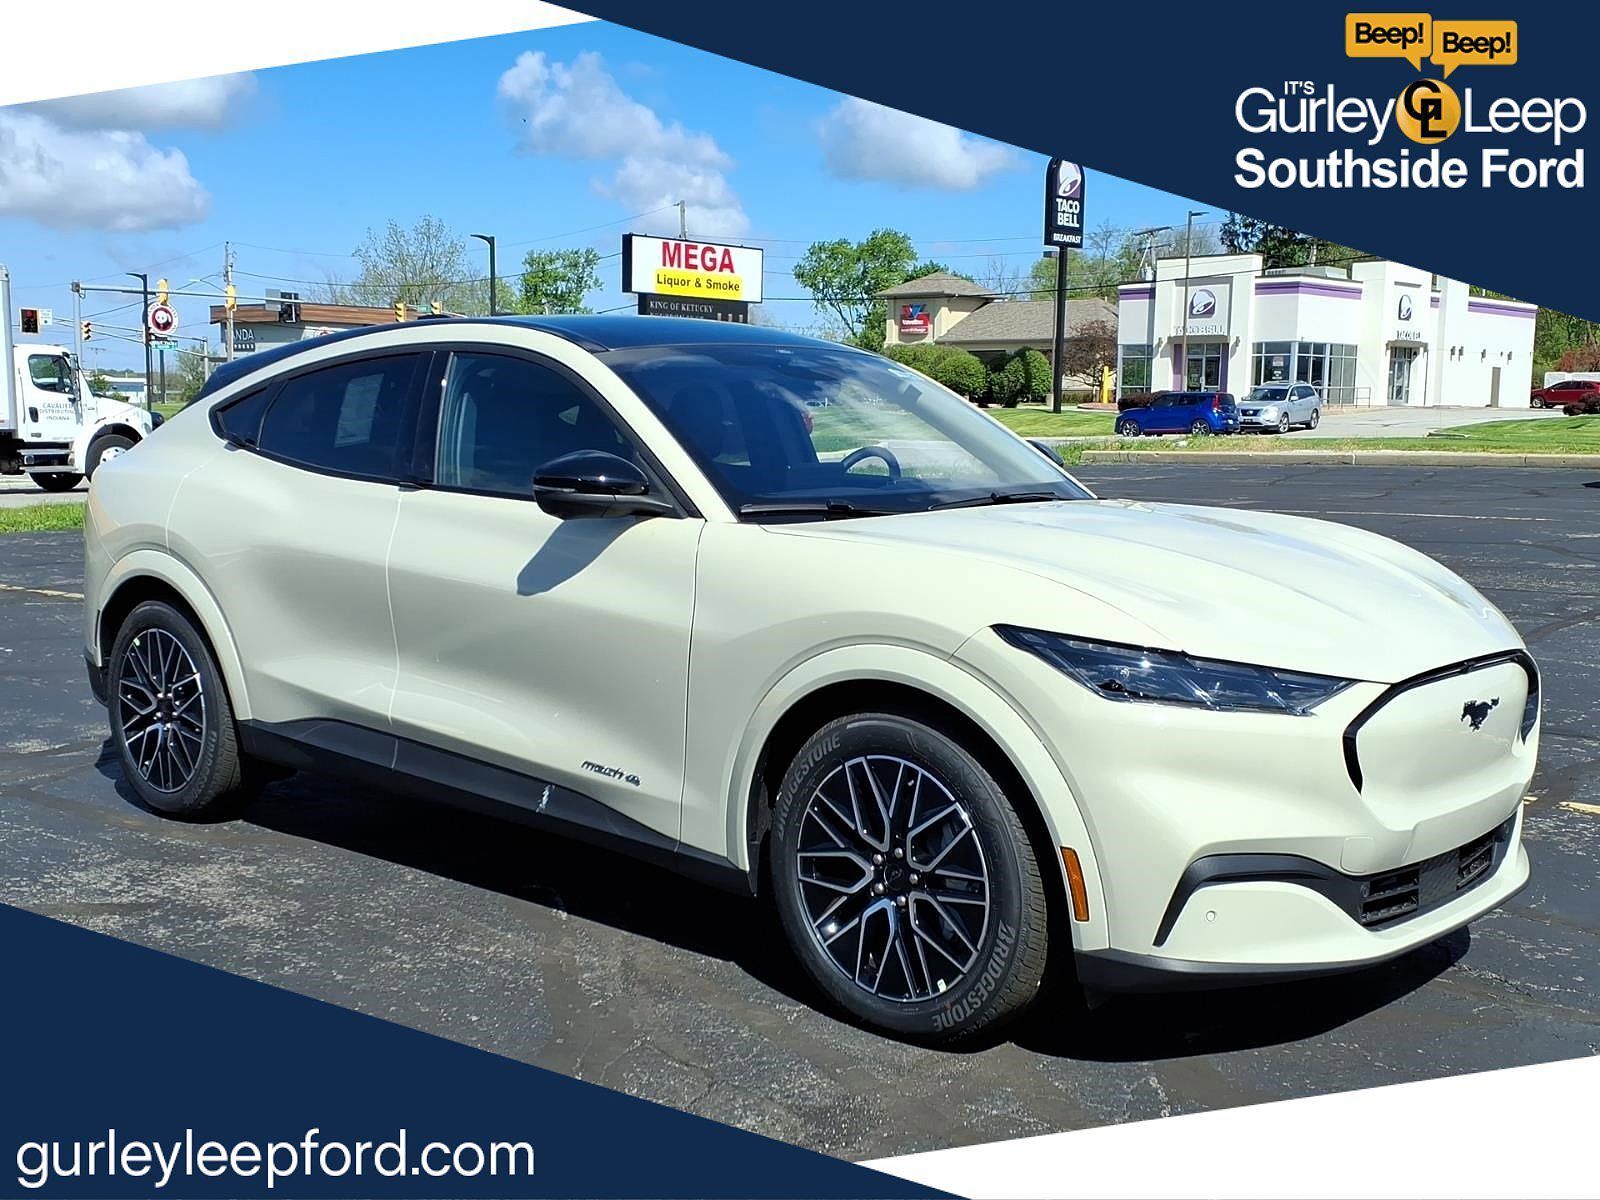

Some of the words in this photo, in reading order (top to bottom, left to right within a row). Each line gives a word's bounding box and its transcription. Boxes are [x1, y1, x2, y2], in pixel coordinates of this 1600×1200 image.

[1056, 198, 1080, 214] TACO
[1057, 212, 1080, 228] BELL
[662, 241, 735, 274] MEGA
[656, 273, 691, 288] Liquor
[694, 277, 702, 288] &
[706, 278, 740, 292] Smoke
[649, 300, 669, 310] KING
[670, 302, 679, 311] OF
[931, 919, 1016, 1032] BRIDGESTONE
